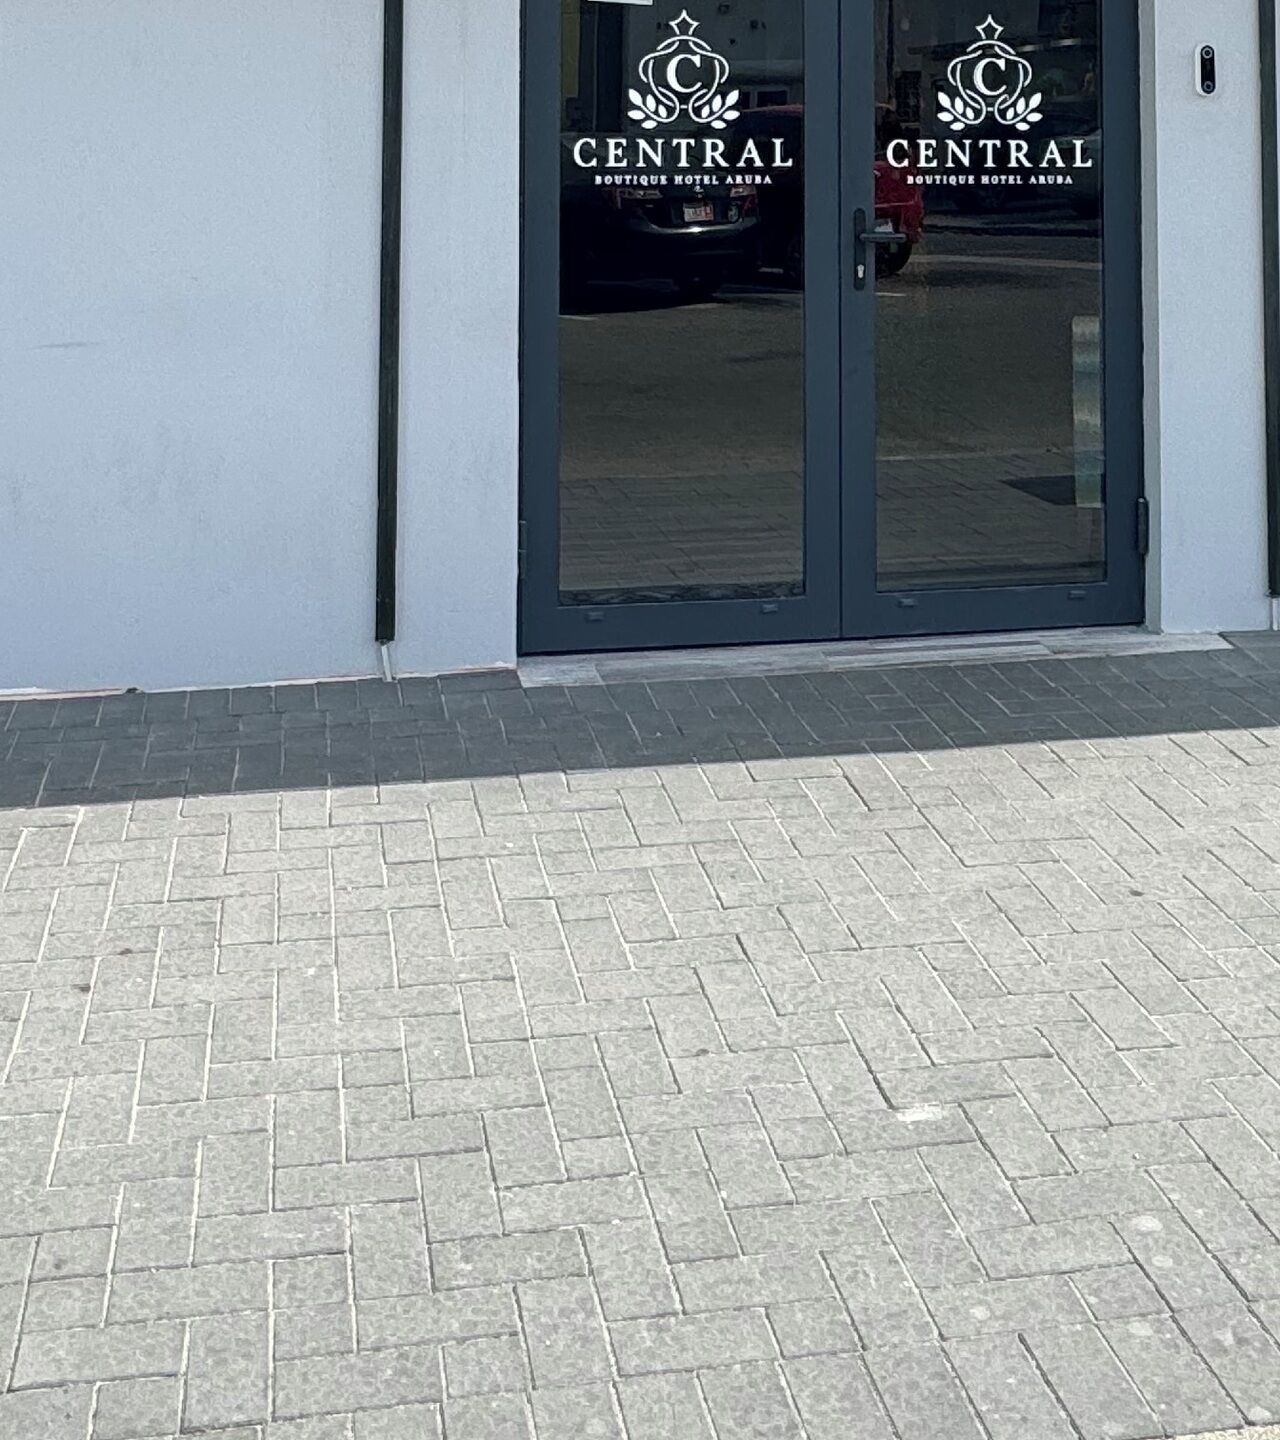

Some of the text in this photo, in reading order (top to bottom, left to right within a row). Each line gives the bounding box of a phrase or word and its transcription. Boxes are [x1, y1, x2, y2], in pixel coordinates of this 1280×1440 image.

[666, 54, 702, 93] C
[973, 58, 1007, 96] C
[573, 137, 793, 168] CENTRAL
[886, 138, 1093, 168] CENTRAL
[594, 174, 772, 187] BOUTIQUE HOTEL ARUBA
[906, 174, 1073, 186] BOUTIQUE HOTEL ARUBA
